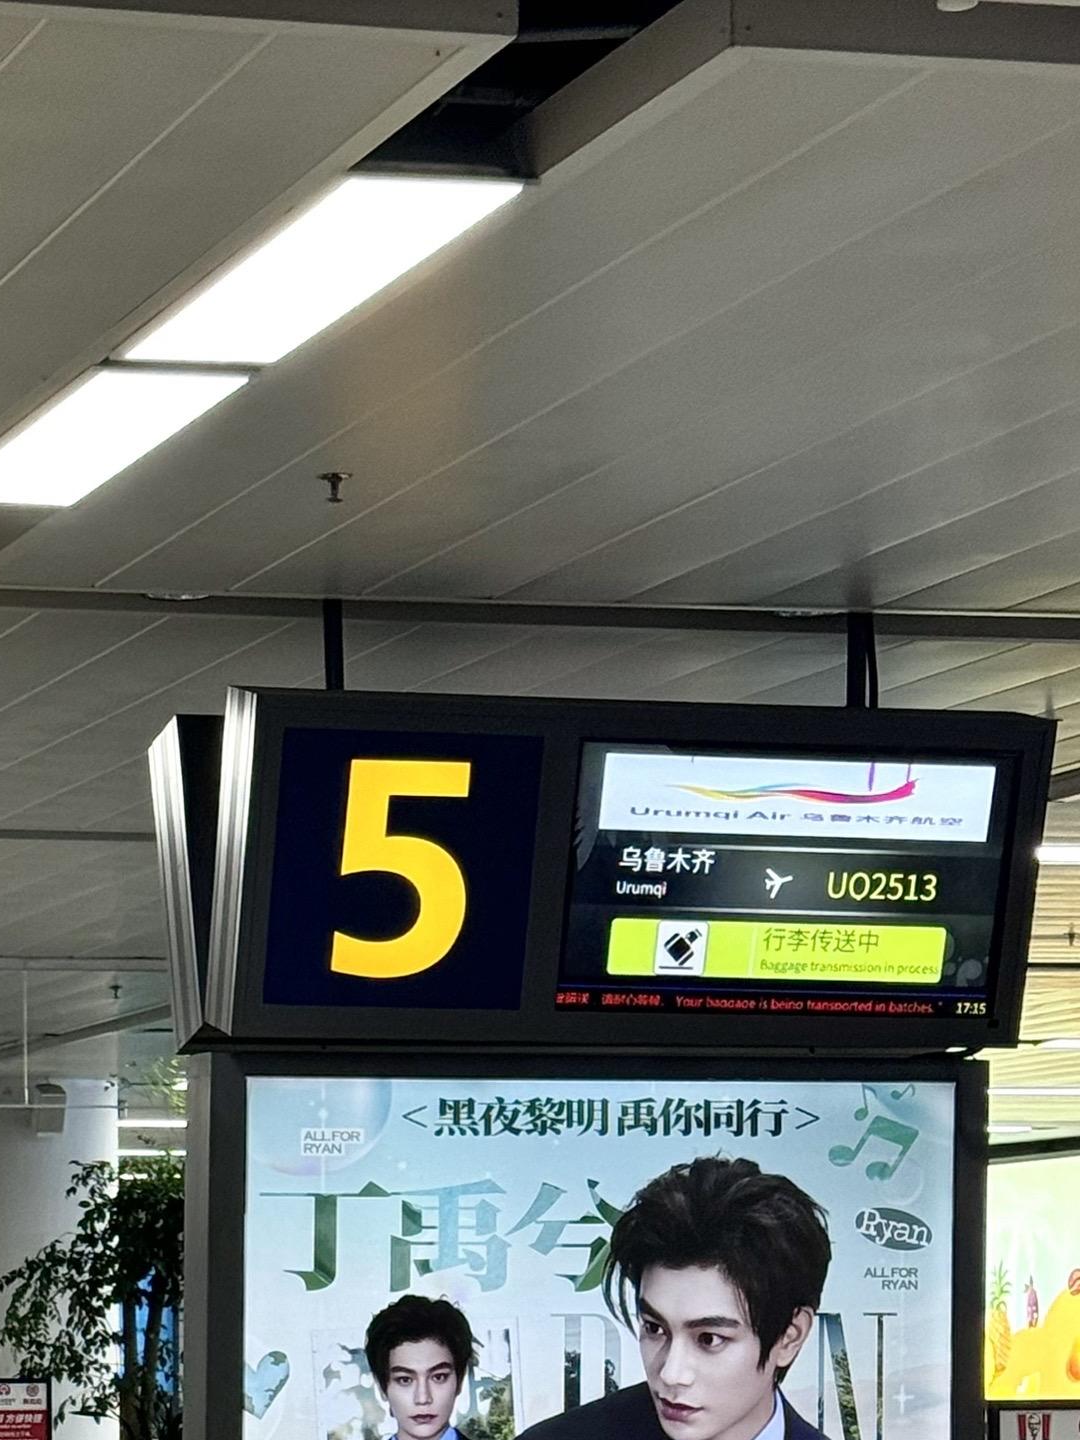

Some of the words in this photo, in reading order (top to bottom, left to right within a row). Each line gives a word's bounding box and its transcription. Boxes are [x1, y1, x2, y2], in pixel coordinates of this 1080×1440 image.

[630, 806, 739, 822] Urumqi
[746, 810, 788, 821] Air
[799, 813, 963, 827] 乌鲁木齐航空
[329, 758, 471, 978] 5
[618, 846, 717, 874] 乌鲁木齐
[616, 880, 668, 899] Urumqi
[827, 870, 938, 902] UQ2513
[762, 928, 880, 954] 行李传送中
[760, 959, 808, 975] Baggage
[810, 960, 881, 973] transmission
[884, 963, 895, 974] in
[897, 965, 939, 977] process
[956, 1002, 987, 1014] 17:15
[304, 1143, 342, 1154] RYAN
[855, 1208, 929, 1246] Ryan
[864, 1267, 889, 1278] ALL
[891, 1267, 919, 1278] FOR
[881, 1280, 919, 1290] RYAN
